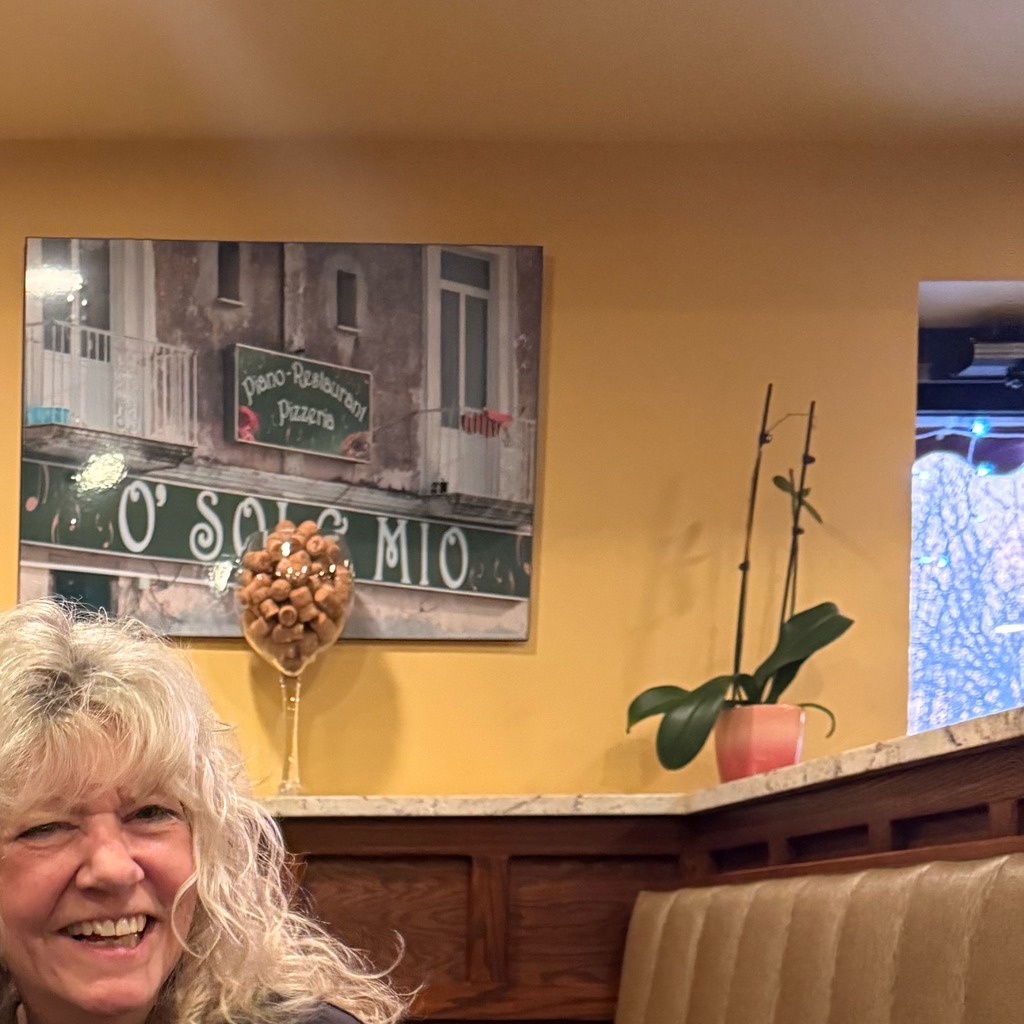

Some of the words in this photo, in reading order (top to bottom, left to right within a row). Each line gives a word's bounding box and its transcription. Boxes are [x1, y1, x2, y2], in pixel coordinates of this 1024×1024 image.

[277, 399, 335, 430] Pizzeria
[118, 480, 167, 552] O'
[374, 516, 469, 589] MIO
